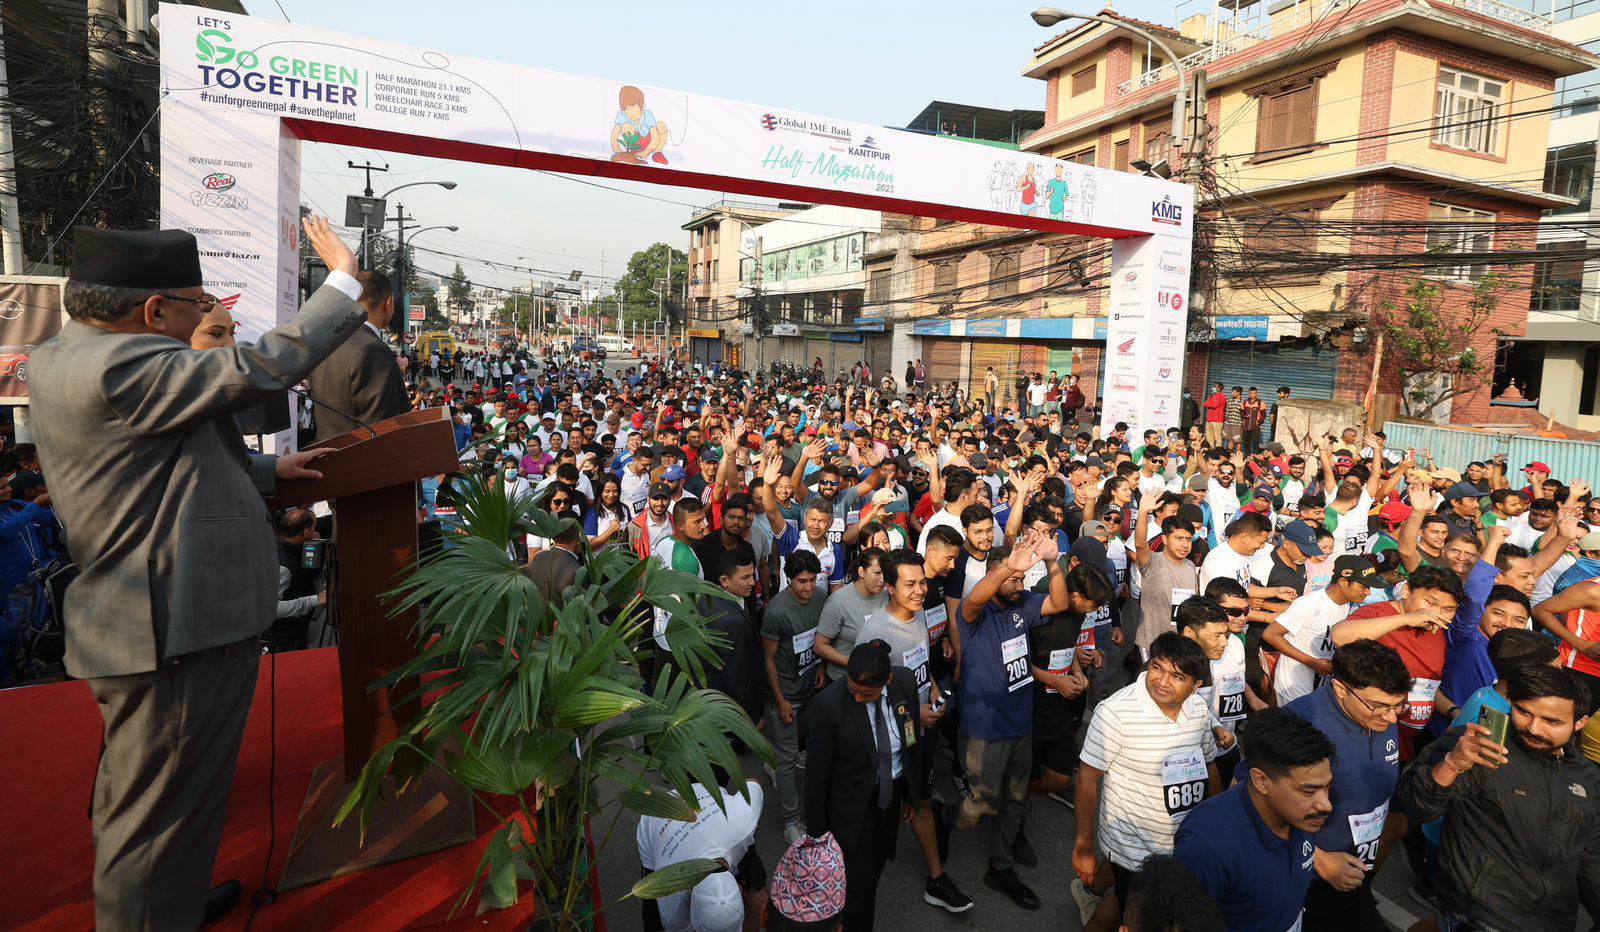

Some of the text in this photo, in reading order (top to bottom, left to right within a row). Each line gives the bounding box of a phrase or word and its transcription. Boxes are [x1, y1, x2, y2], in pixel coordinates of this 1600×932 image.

[197, 16, 231, 30] LET'S
[270, 56, 358, 86] GREEN
[198, 65, 358, 107] TOGETHER
[375, 73, 472, 95] HALF MARATHON 21.1 KMS
[375, 82, 419, 97] CORPORATE
[420, 90, 436, 99] RUN
[443, 94, 460, 103] KMS
[200, 91, 356, 121] #runforgreennepal #savetheplanet
[374, 93, 423, 107] WHEELCHAIR
[424, 101, 443, 110] RACE
[451, 105, 468, 113] KMS
[374, 103, 408, 115] COLLEGE
[409, 109, 425, 118] RUN
[433, 112, 450, 121] KMS
[779, 117, 807, 130] Global
[810, 122, 828, 133] IME
[831, 125, 852, 137] Bank
[189, 156, 253, 169] BEVERAGE PARTNER
[848, 146, 891, 161] KANTIPUR
[207, 175, 233, 190] Real
[875, 183, 895, 193] 2023
[1152, 201, 1182, 220] KMG
[188, 227, 223, 236] COMMERCE
[799, 648, 815, 666] 49
[914, 664, 927, 685] 20
[1007, 657, 1028, 682] 209
[1223, 694, 1243, 713] 728
[1168, 781, 1205, 809] 689
